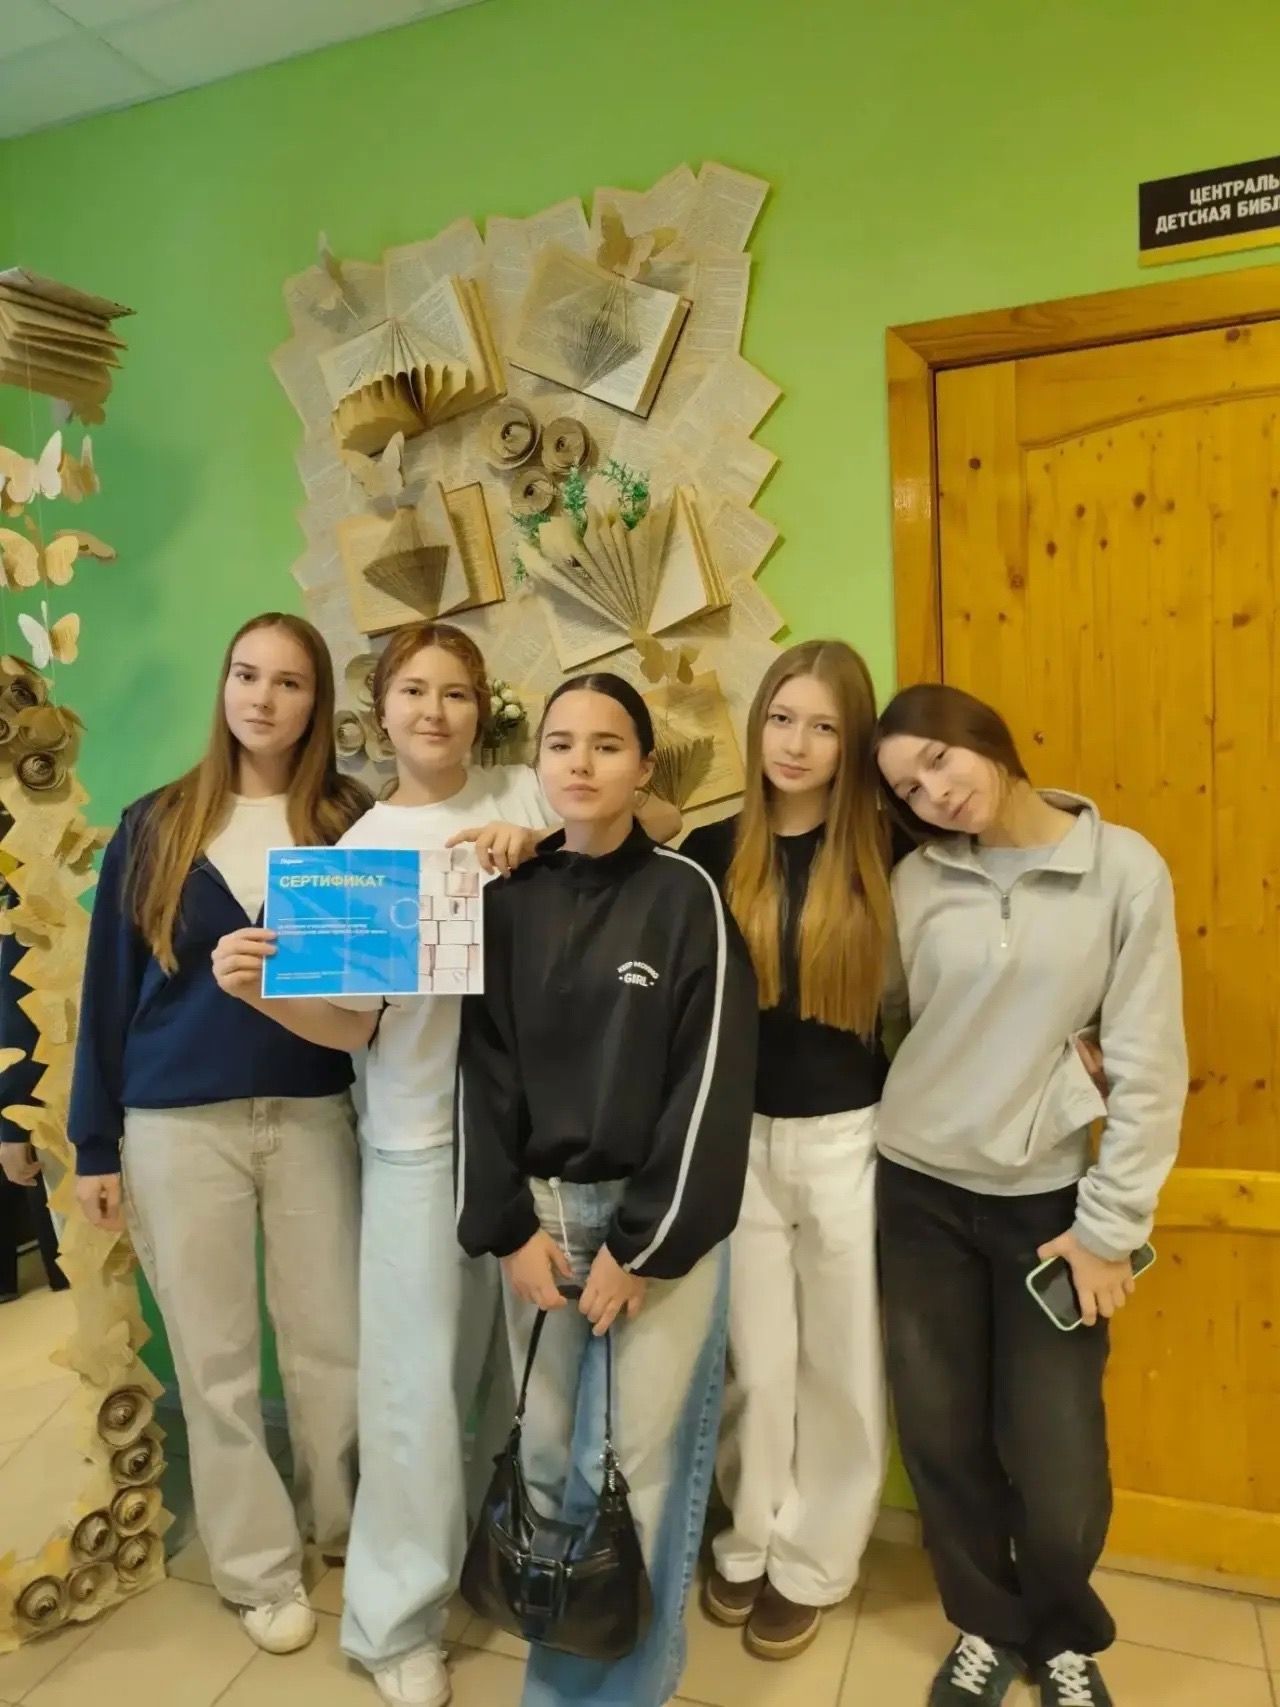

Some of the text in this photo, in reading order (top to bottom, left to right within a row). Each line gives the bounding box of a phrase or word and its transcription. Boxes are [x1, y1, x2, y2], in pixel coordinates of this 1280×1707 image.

[1189, 174, 1280, 206] ЦЕНТРАЛЬ
[1155, 203, 1232, 235] ДЕТСКАЯ
[279, 874, 386, 888] СЕРТИФИКАТ
[623, 972, 648, 987] GIRL
